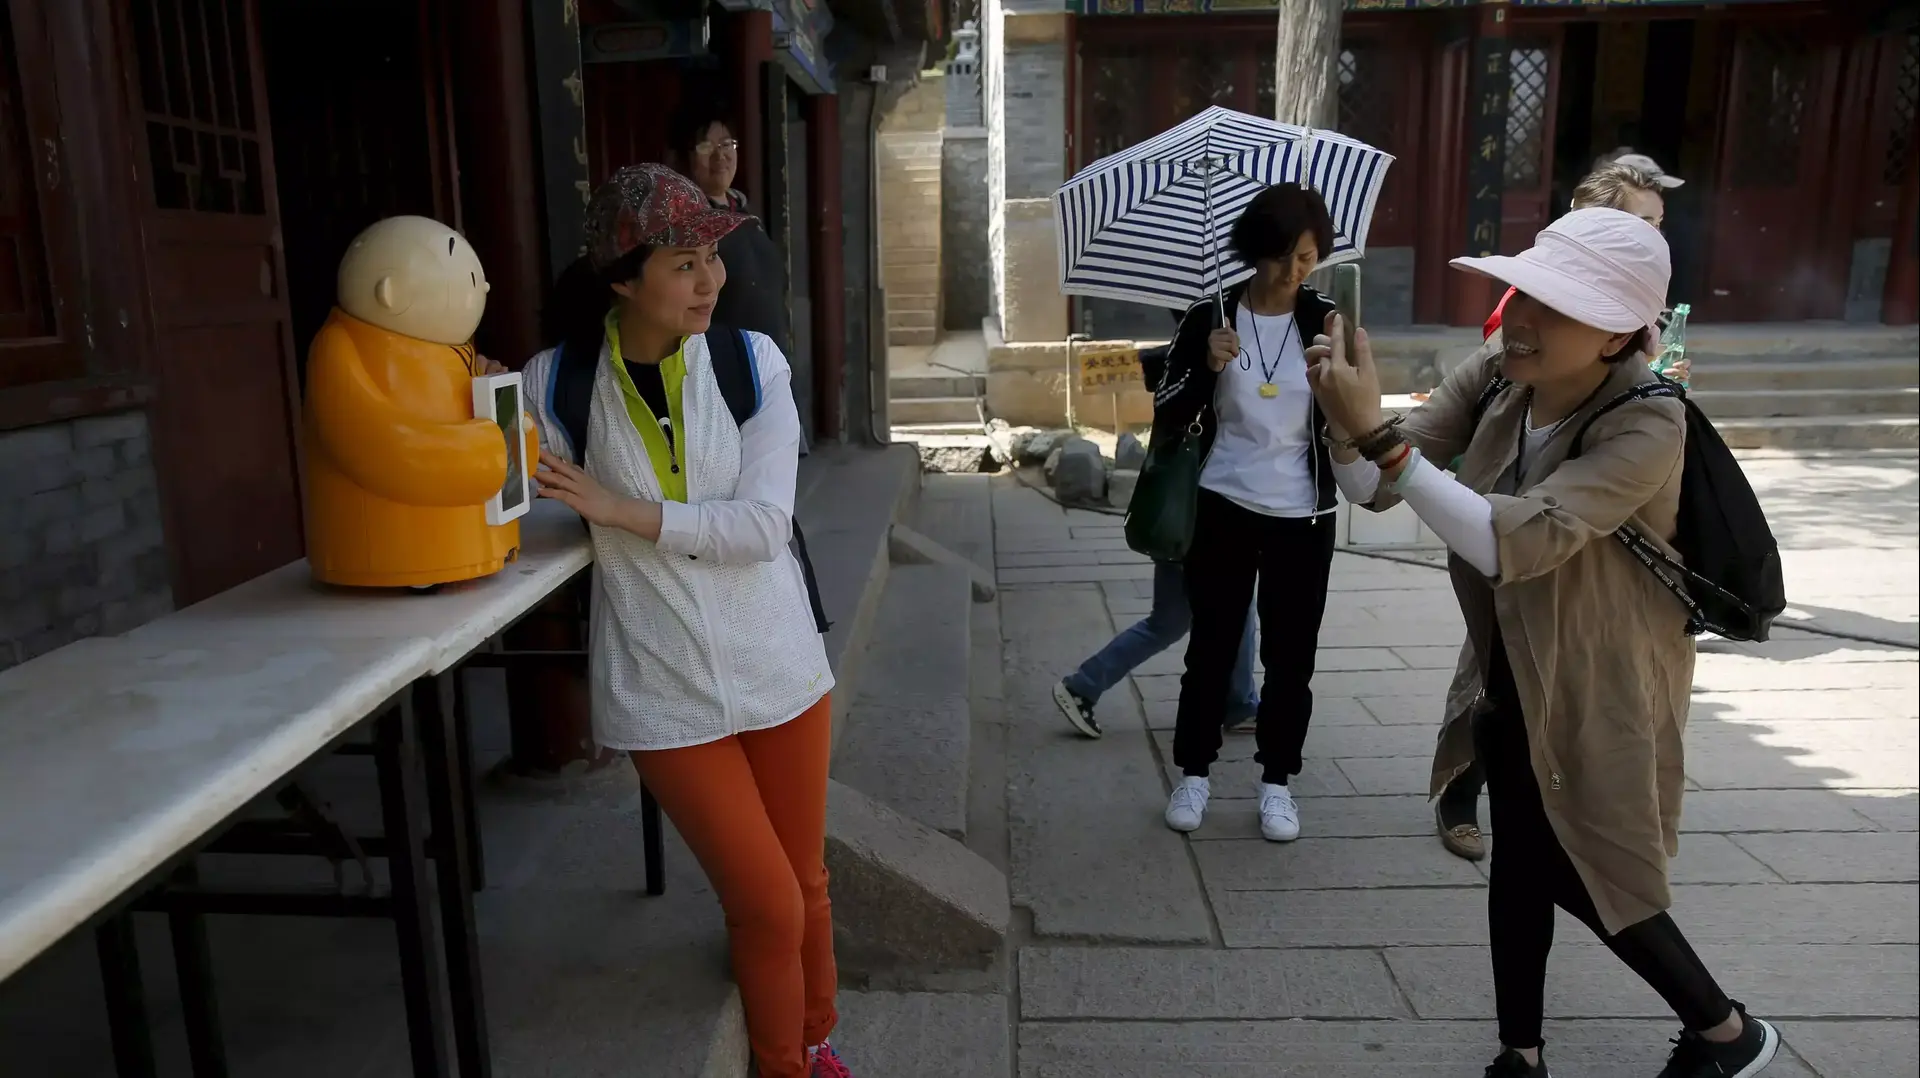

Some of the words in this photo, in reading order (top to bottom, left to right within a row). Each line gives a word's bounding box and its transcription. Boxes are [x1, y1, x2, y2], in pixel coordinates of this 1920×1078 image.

[1474, 52, 1503, 257] 正法利人间
